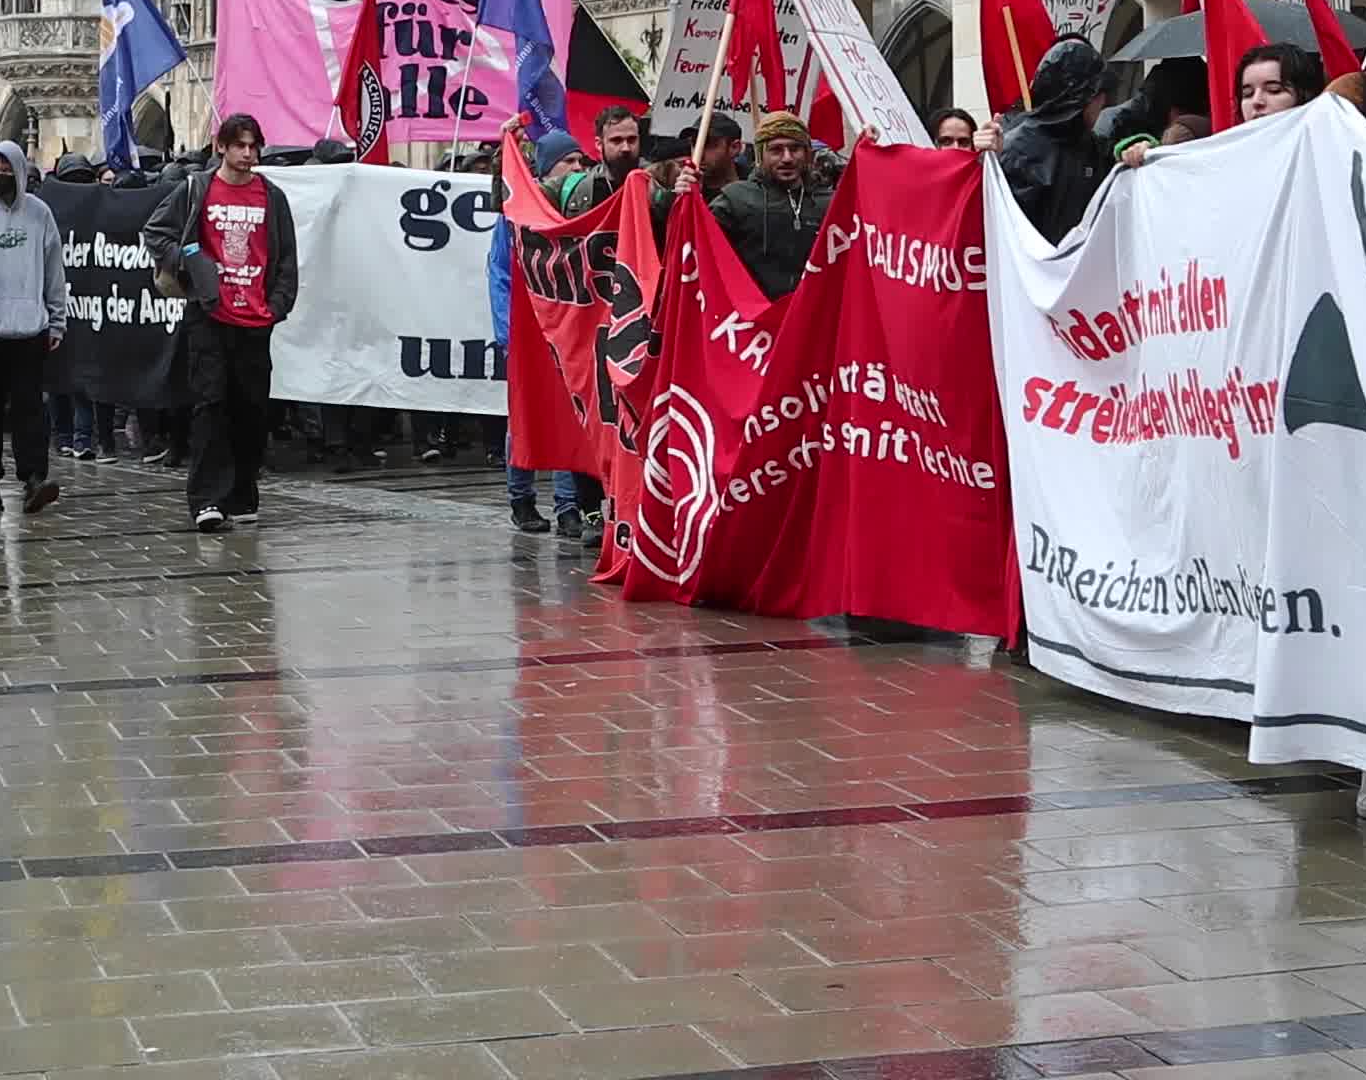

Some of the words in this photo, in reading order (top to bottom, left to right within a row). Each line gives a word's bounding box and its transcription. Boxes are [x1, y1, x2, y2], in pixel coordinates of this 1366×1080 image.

[664, 91, 685, 108] den
[62, 230, 91, 268] der
[94, 230, 156, 270] Revolu
[106, 283, 135, 324] der
[1177, 258, 1228, 333] allen
